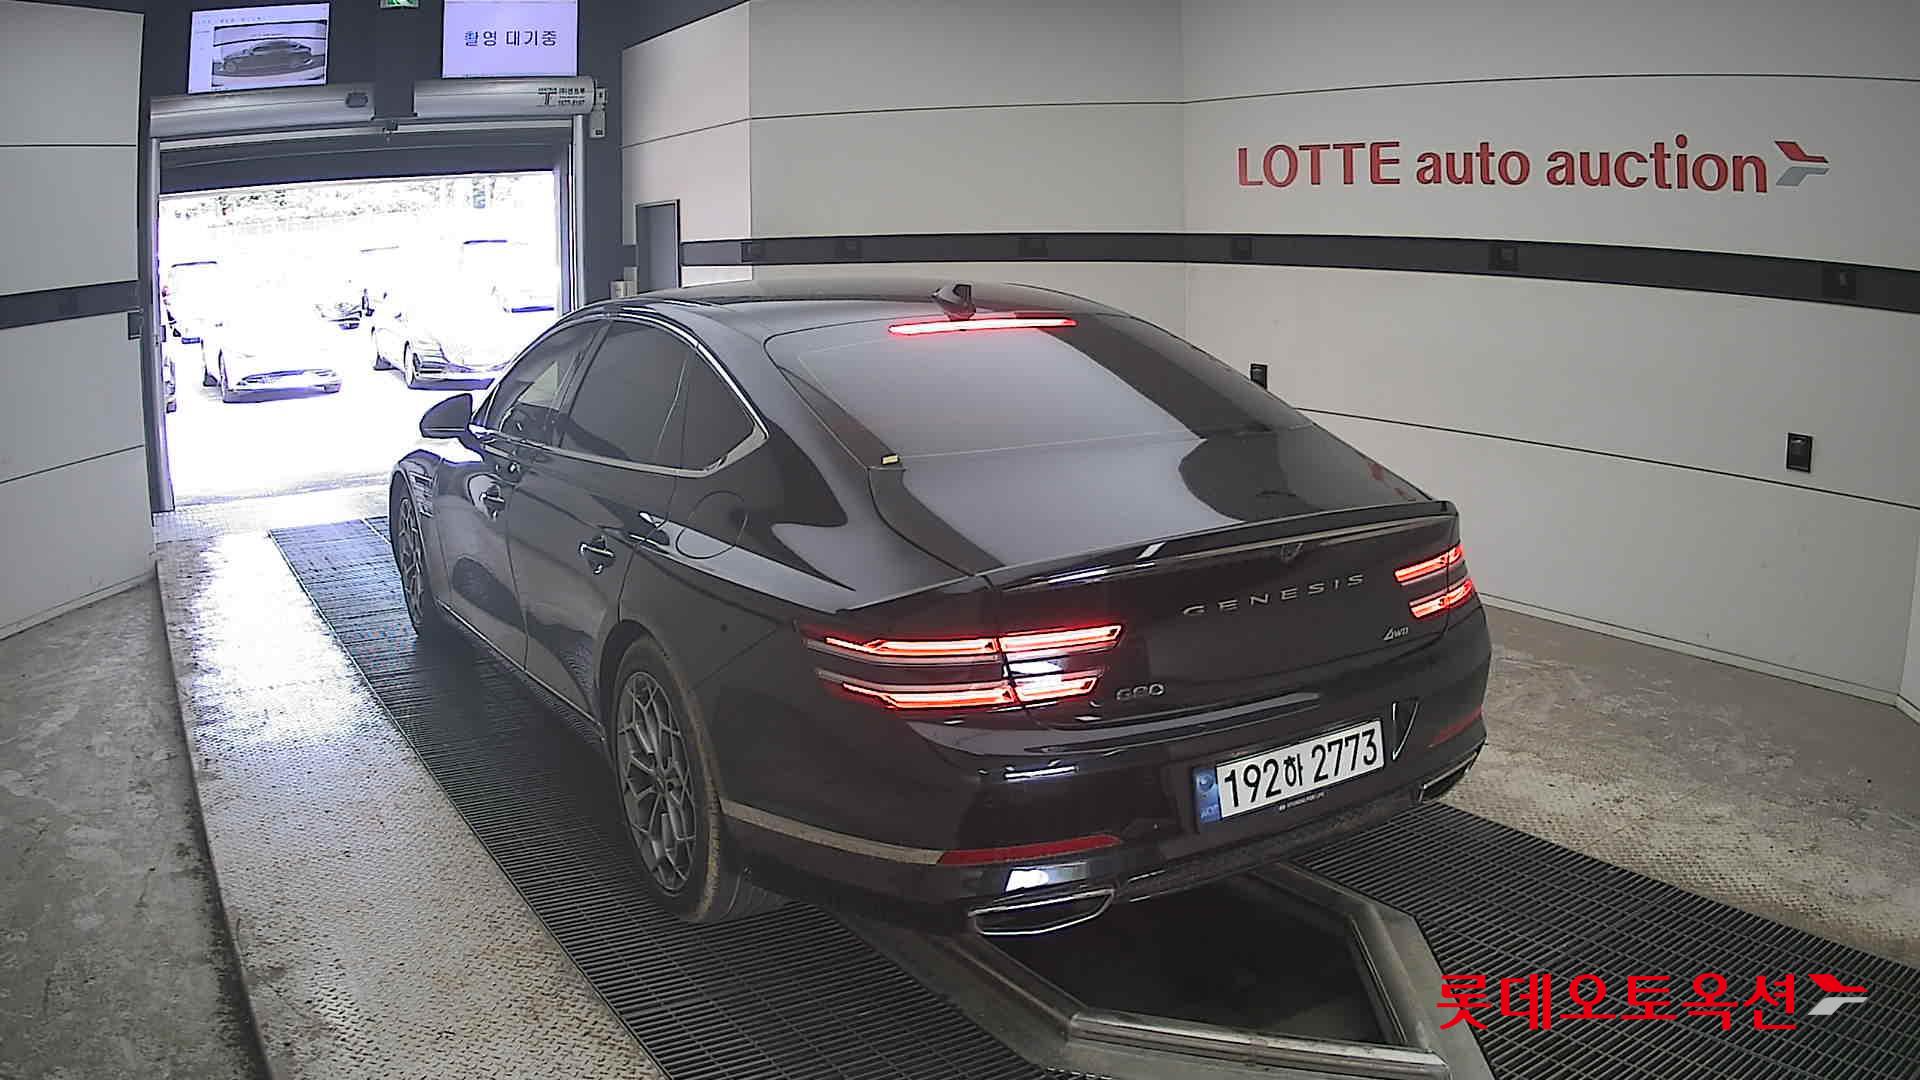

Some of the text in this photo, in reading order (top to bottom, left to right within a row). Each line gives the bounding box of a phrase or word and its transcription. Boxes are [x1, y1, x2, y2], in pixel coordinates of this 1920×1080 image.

[505, 29, 557, 47] 대기중
[1238, 134, 1768, 193] LOTTE auto auction
[1183, 574, 1363, 616] GENESIS
[1224, 729, 1378, 808] 192하 2773
